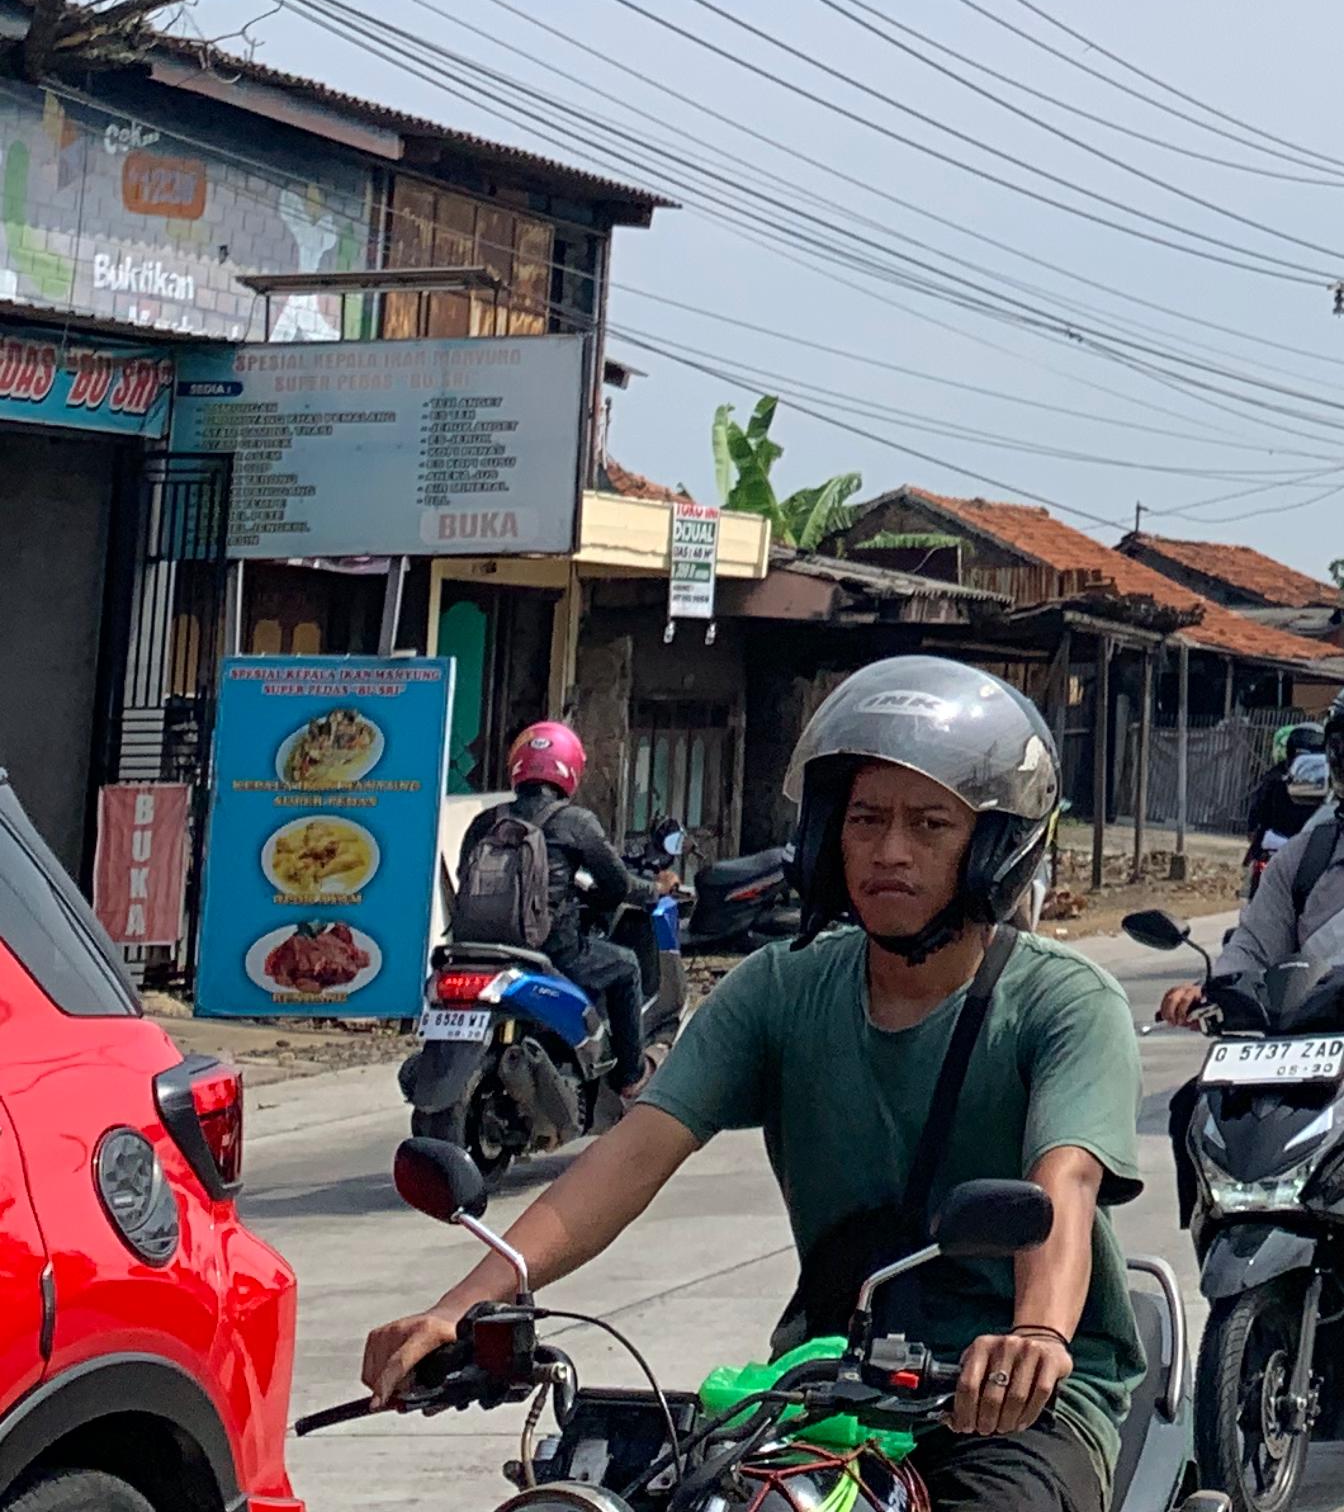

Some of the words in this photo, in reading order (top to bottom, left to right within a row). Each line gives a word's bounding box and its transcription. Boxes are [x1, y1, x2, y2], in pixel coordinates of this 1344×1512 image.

[94, 253, 196, 300] Buktikan
[437, 511, 519, 539] BUKA
[674, 521, 714, 543] DIJUAL
[124, 794, 155, 937] BUKA
[1239, 1043, 1292, 1061] 5737
[1301, 1040, 1344, 1058] ZAD
